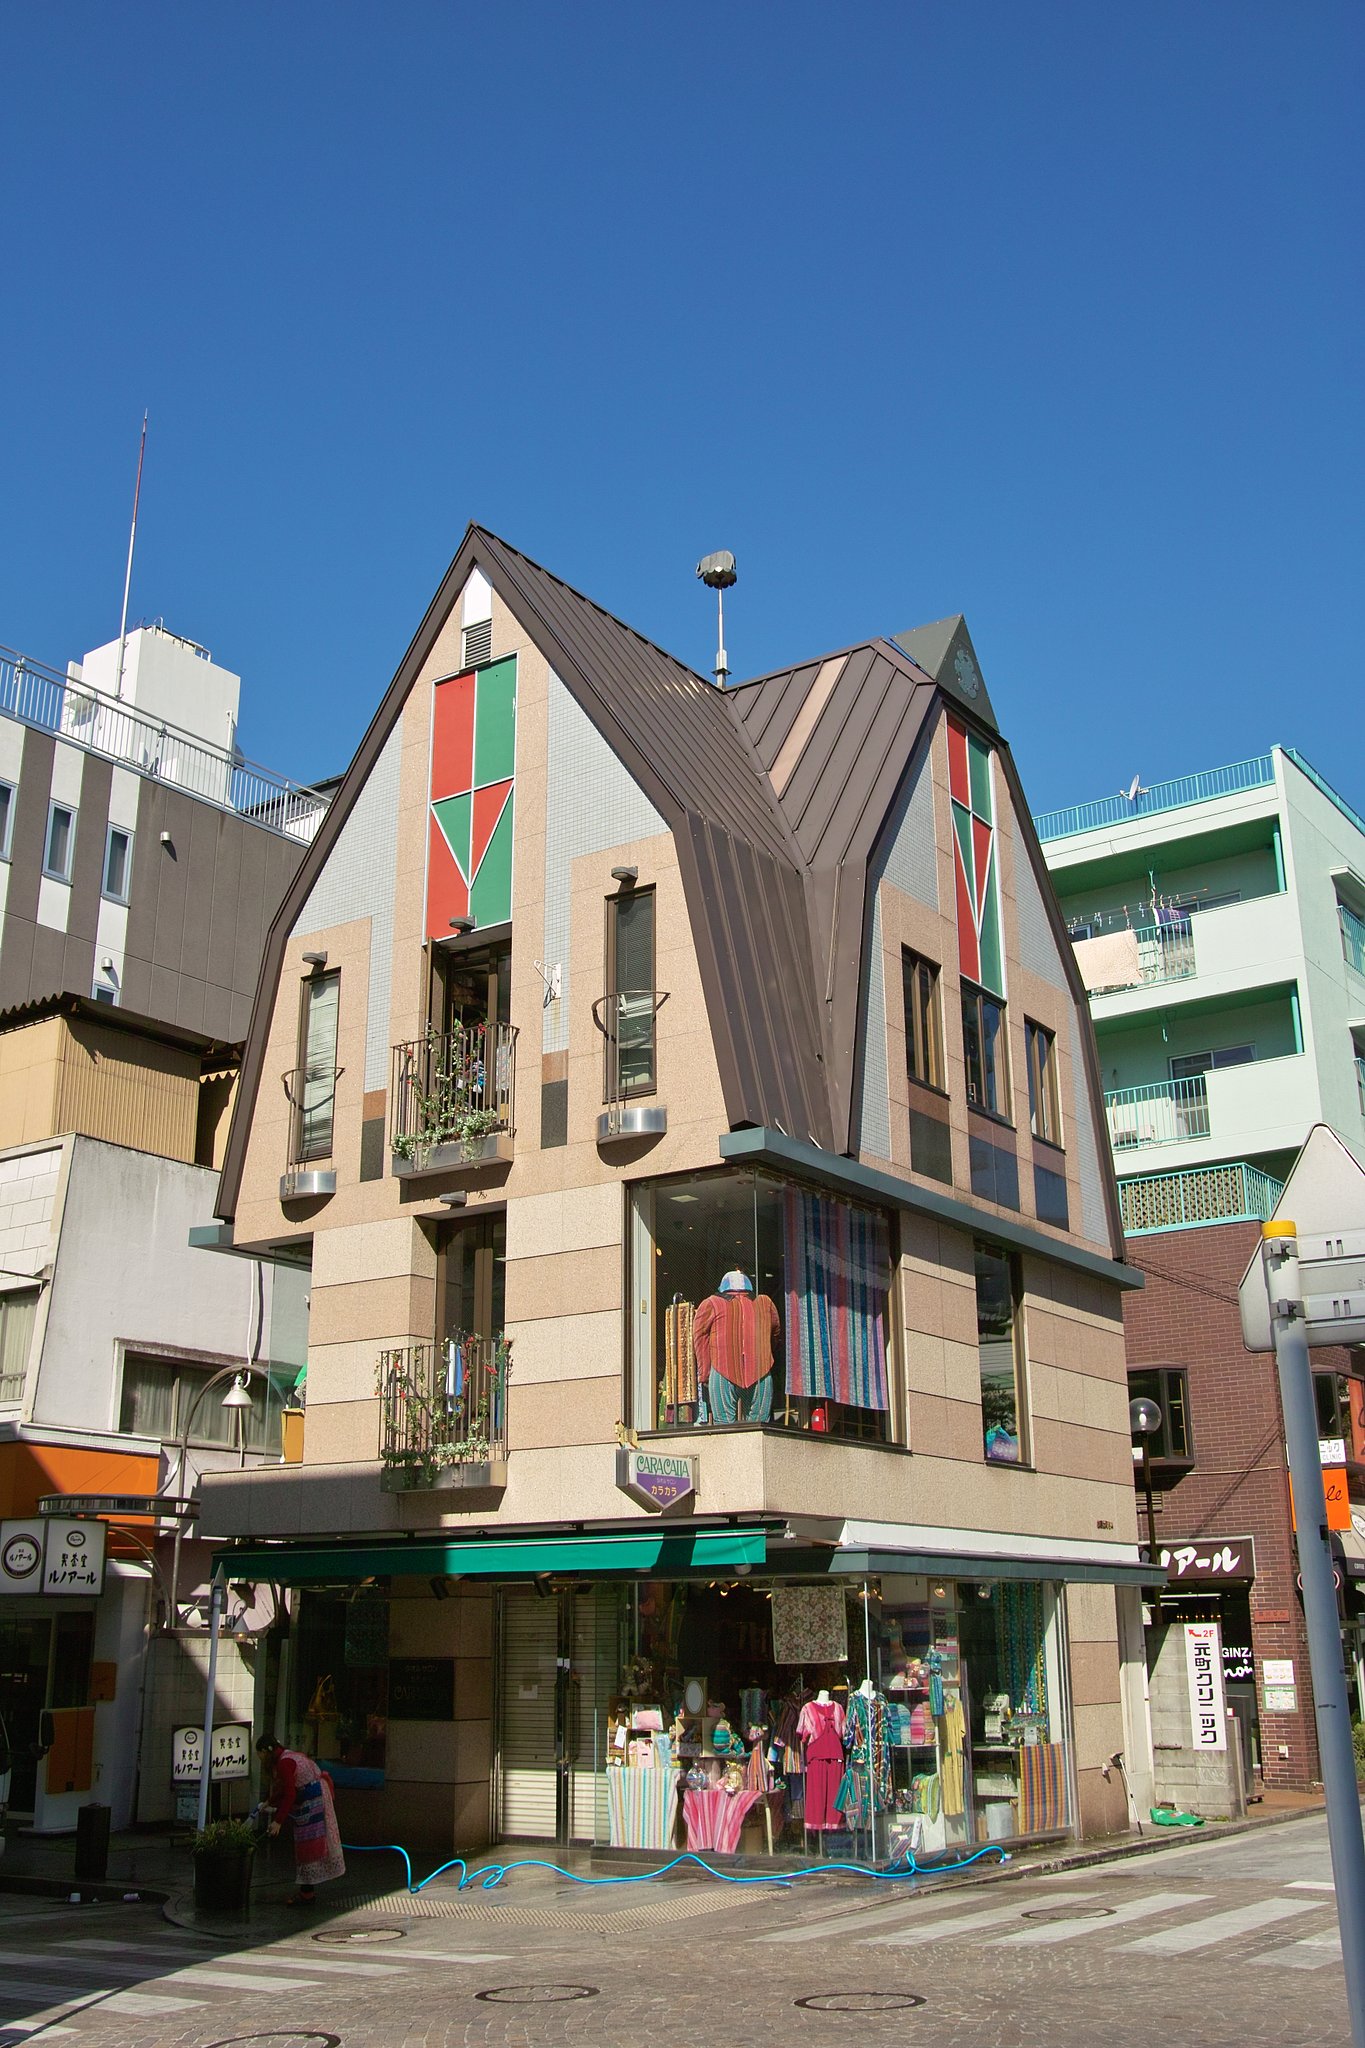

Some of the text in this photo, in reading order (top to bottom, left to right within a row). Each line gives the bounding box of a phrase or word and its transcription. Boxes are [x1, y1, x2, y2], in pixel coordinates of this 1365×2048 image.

[651, 1485, 677, 1496] カラカラ
[9, 1553, 32, 1562] ルノアール
[61, 1552, 88, 1567] 喫茶室
[1141, 1546, 1241, 1576] ノアール
[48, 1570, 97, 1585] ルノアール
[1203, 1629, 1215, 1638] 2F
[1221, 1647, 1252, 1658] GINZ
[1194, 1642, 1218, 1744] 元町クリニック
[220, 1736, 241, 1749] 喫茶室
[212, 1754, 248, 1769] ルノアール
